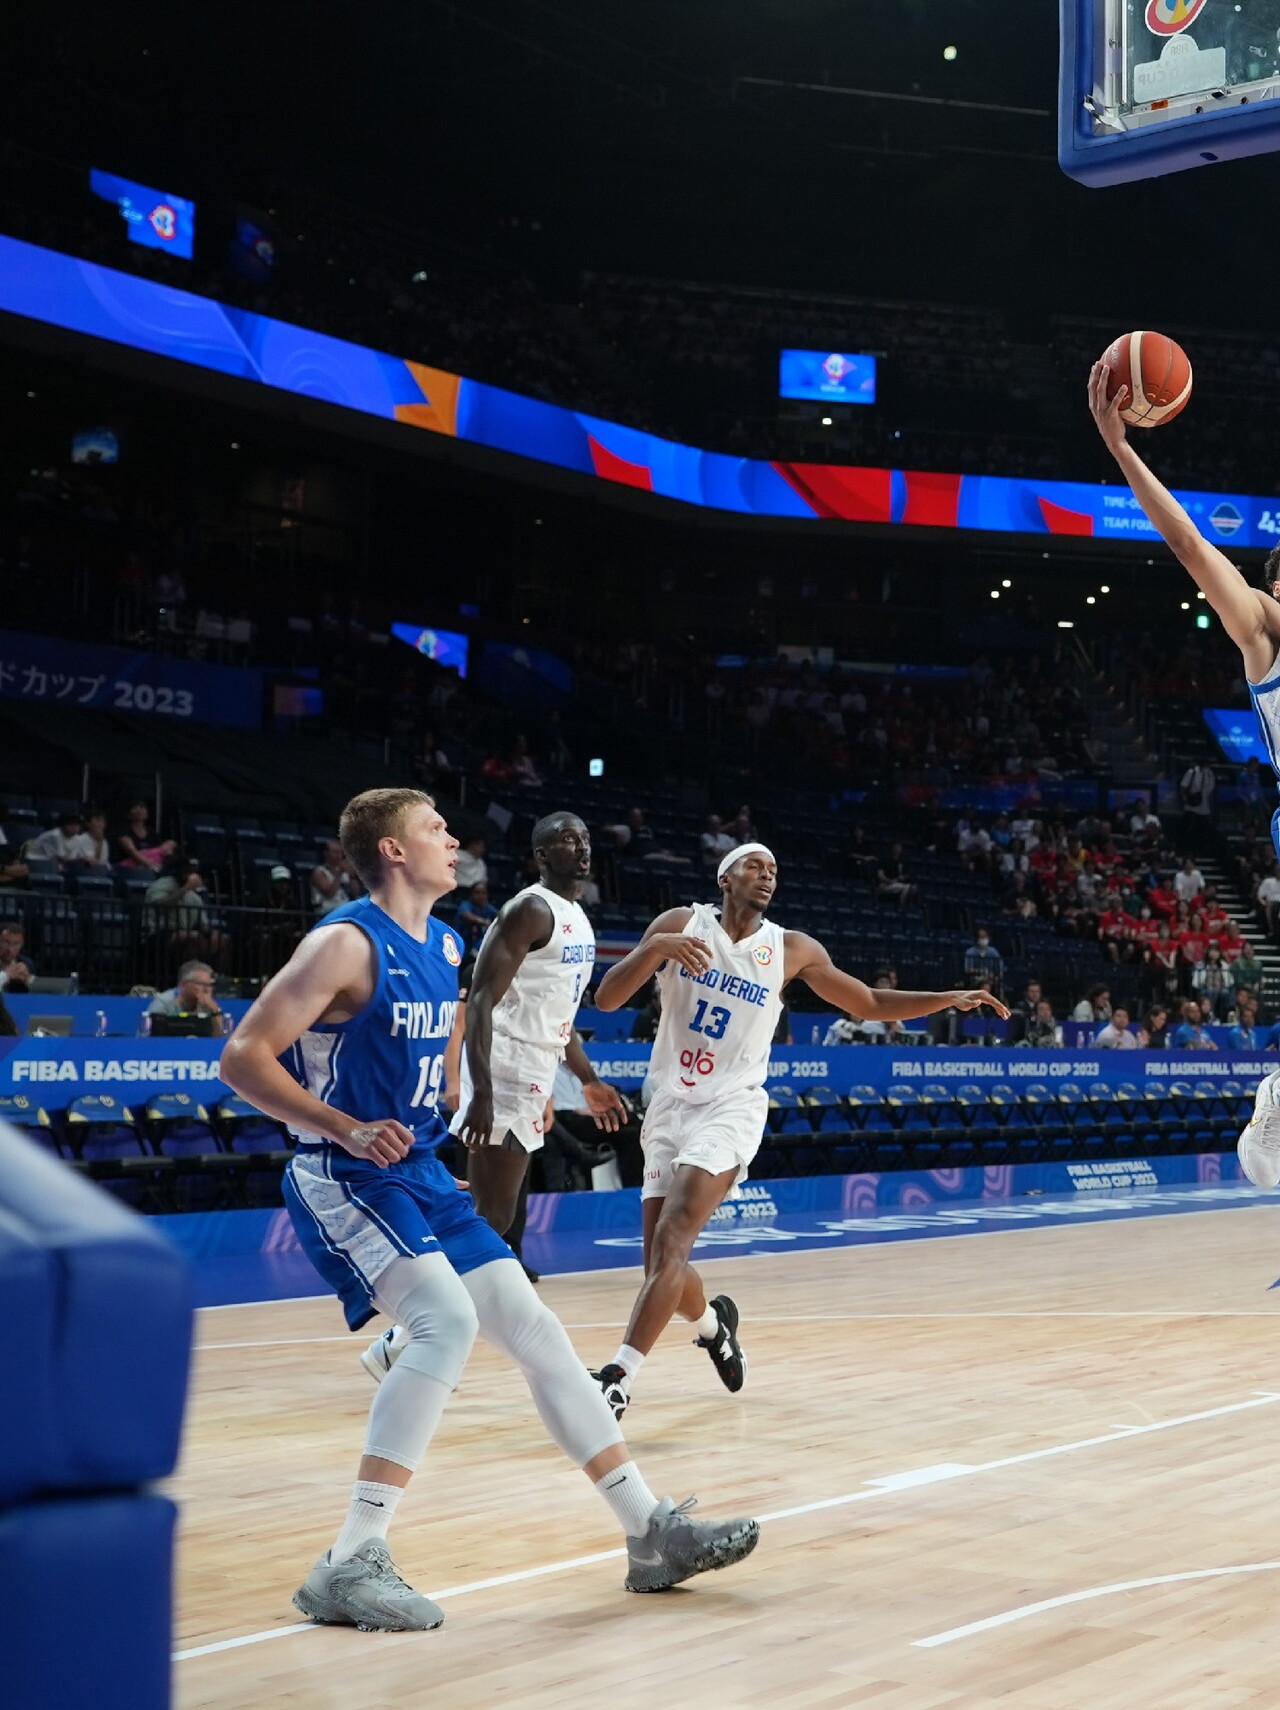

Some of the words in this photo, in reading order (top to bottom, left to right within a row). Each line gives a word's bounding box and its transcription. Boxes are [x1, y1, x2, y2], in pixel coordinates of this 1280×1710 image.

[113, 681, 194, 716] 2023
[720, 972, 769, 1007] VERDE
[689, 998, 732, 1040] 13
[12, 1060, 78, 1082] FIBA
[84, 1060, 220, 1081] BASKETBA
[766, 1061, 789, 1078] UP
[791, 1061, 828, 1078] 2023
[892, 1062, 922, 1077] FIBA
[924, 1062, 1004, 1077] BASKETBALL
[1008, 1063, 1047, 1077] WORLD
[1049, 1063, 1072, 1077] CUP
[1073, 1063, 1099, 1077] 2023
[1145, 1062, 1169, 1076] FIBA
[1169, 1062, 1231, 1076] BASKETBALL
[1231, 1062, 1261, 1076] WORLD
[410, 1053, 444, 1108] 19
[1091, 1160, 1152, 1175] BASKETBALL
[1072, 1176, 1113, 1191] WORLD
[1111, 1174, 1133, 1188] CUP
[1132, 1172, 1158, 1186] 2023
[738, 1202, 778, 1219] 2023
